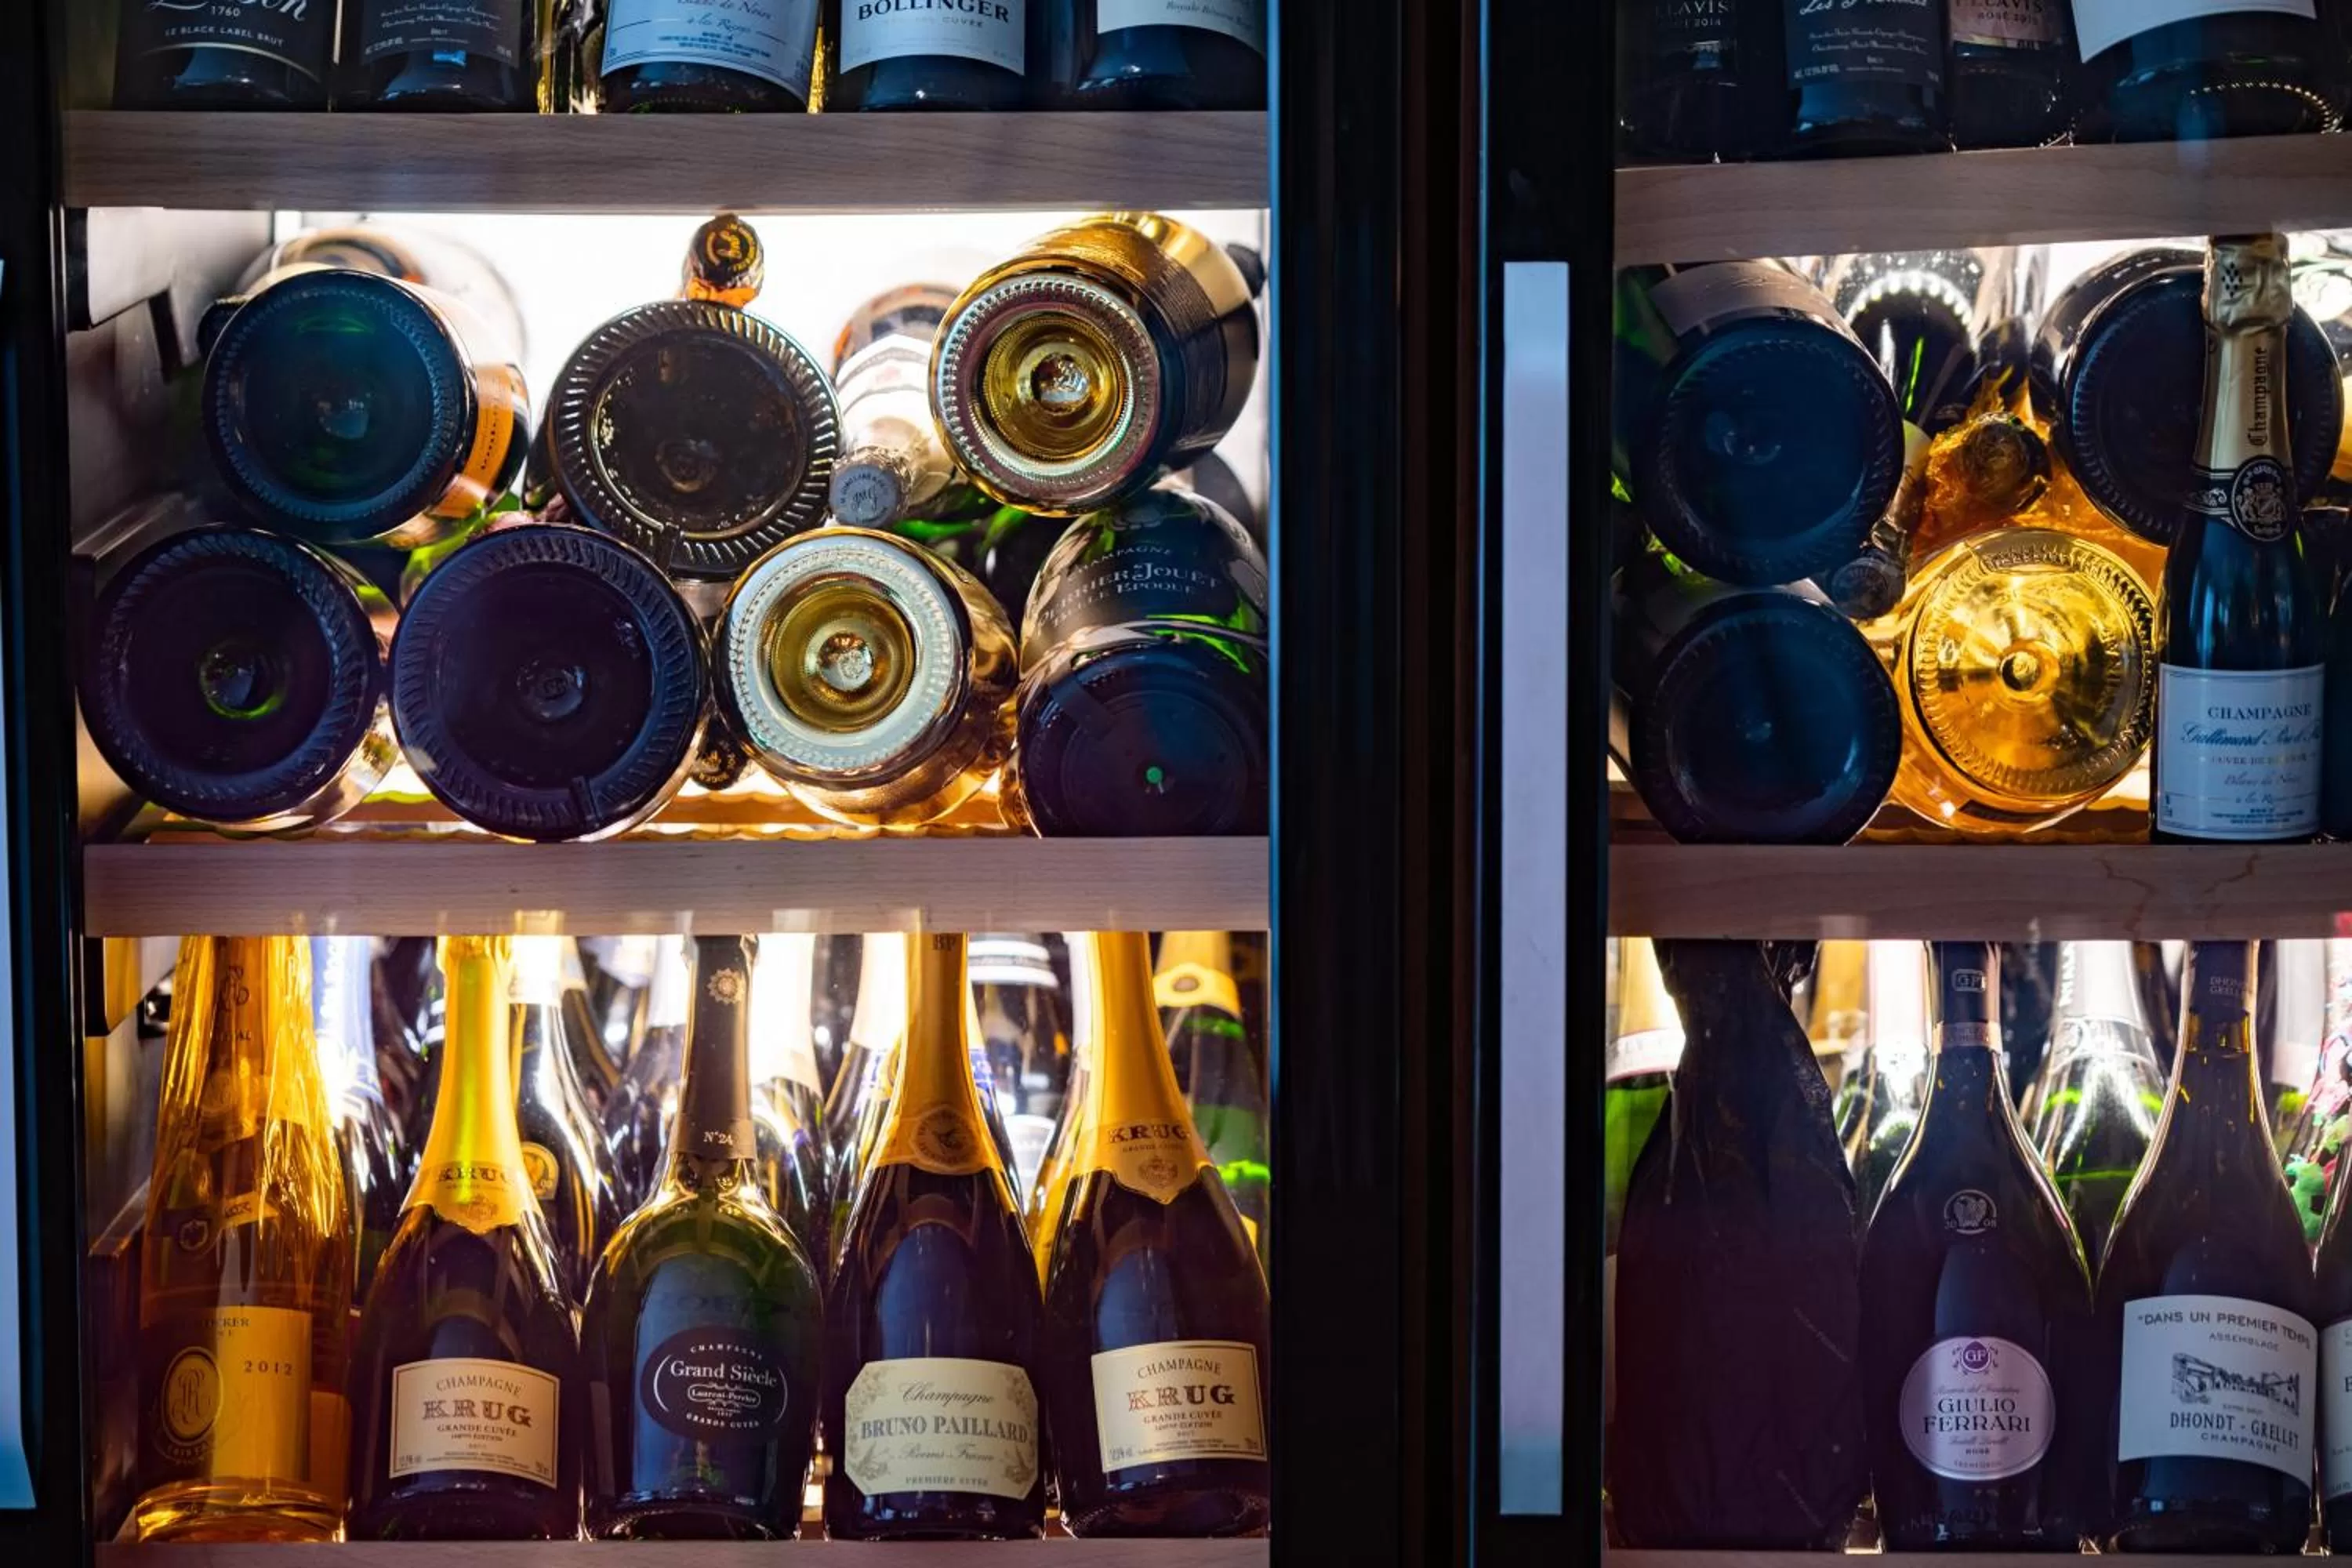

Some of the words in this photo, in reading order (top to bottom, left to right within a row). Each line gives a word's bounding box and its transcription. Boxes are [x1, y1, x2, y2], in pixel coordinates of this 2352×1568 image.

[211, 5, 241, 17] 1760
[858, 0, 1010, 24] BOLLINGER
[180, 25, 216, 34] BLACK
[220, 27, 255, 38] LABEL
[257, 32, 285, 48] BRUT
[2247, 347, 2268, 447] Champagne
[1068, 545, 1173, 582] HAMPAGNE
[2207, 702, 2312, 720] CHAMPAGNE
[1108, 1123, 1192, 1144] KRUG
[437, 1166, 514, 1185] KRU
[2190, 1311, 2211, 1323] UN
[2216, 1312, 2278, 1333] PREMIER
[690, 1342, 763, 1361] CHAMPAGNE
[2209, 1332, 2279, 1352] ASSEMBLAGE
[1965, 1348, 1987, 1362] GF
[244, 1359, 293, 1377] 2012
[670, 1359, 725, 1379] Grand
[729, 1363, 778, 1388] Siècle
[1138, 1357, 1222, 1379] CHAMPAGNE
[436, 1375, 522, 1396] CHAMPAGNE
[897, 1379, 996, 1407] Champagne
[1127, 1385, 1236, 1412] KRUG
[1937, 1398, 2016, 1414] GIULIO
[423, 1399, 532, 1428] KRUG
[1144, 1412, 1188, 1424] GRANDE
[437, 1424, 481, 1433] GRANDE
[861, 1415, 927, 1440] BRUNO
[934, 1415, 1029, 1444] PAILLARD
[1923, 1415, 2031, 1434] FERRARI
[2169, 1411, 2236, 1431] DHONDT
[2251, 1419, 2299, 1450] GRELLET
[2201, 1432, 2278, 1454] CHAMPAGNE
